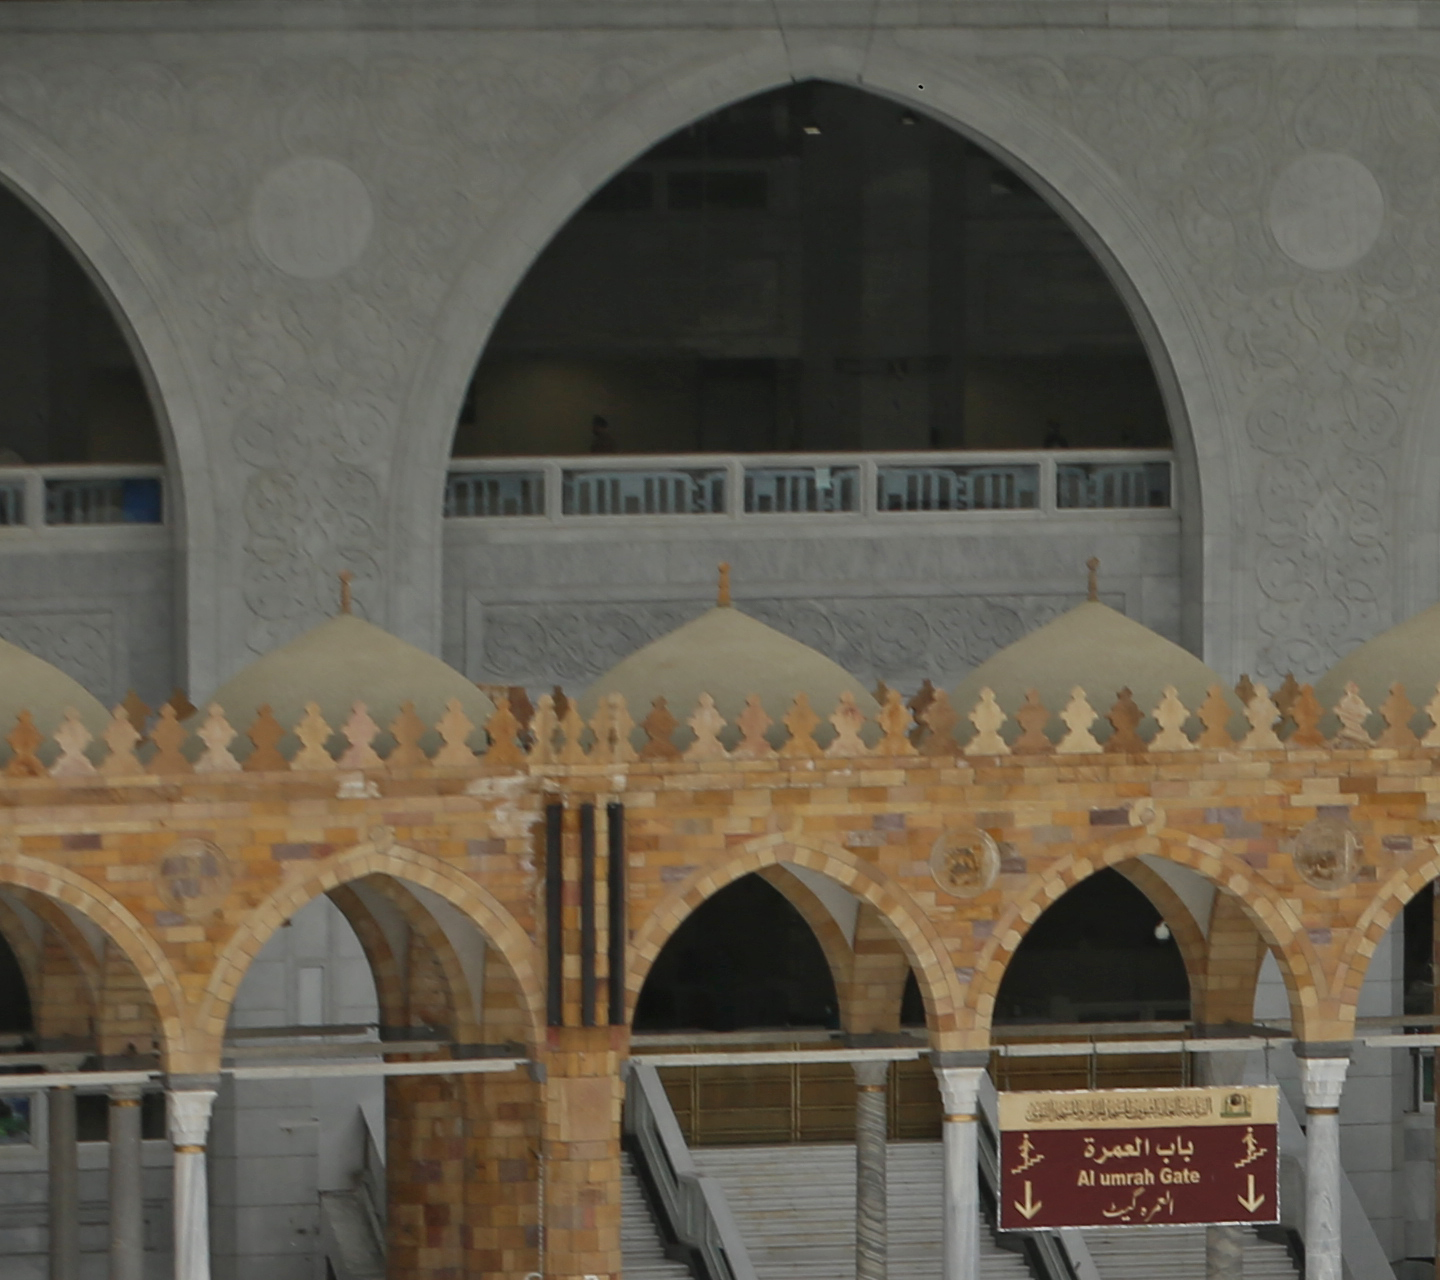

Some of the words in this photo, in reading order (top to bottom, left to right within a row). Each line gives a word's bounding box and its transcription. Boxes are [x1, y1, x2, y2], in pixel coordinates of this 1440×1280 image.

[1084, 1136, 1149, 1164] العمرة
[1156, 1135, 1194, 1164] باب
[1077, 1169, 1095, 1186] Al
[1100, 1168, 1155, 1186] umrah
[1160, 1167, 1200, 1184] Gate
